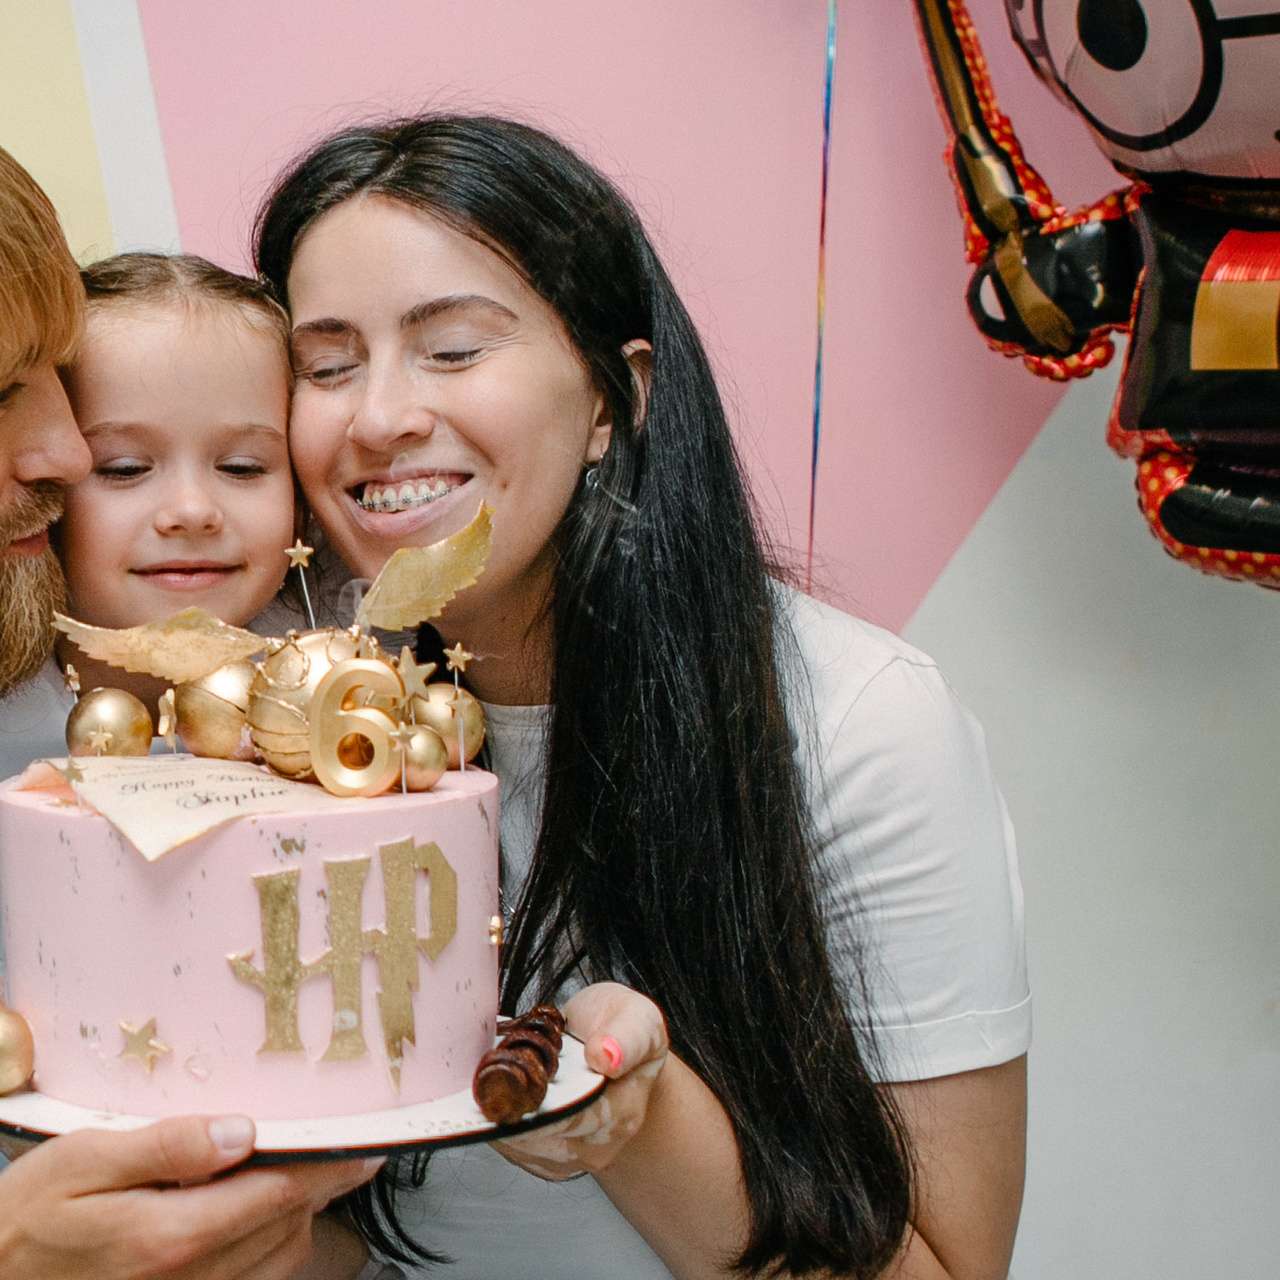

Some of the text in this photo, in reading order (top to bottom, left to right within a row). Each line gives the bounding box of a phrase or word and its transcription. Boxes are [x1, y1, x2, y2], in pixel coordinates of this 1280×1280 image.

[310, 658, 406, 797] 6
[122, 777, 196, 796] Happy
[177, 786, 290, 808] Sophie
[226, 836, 457, 1094] HP
